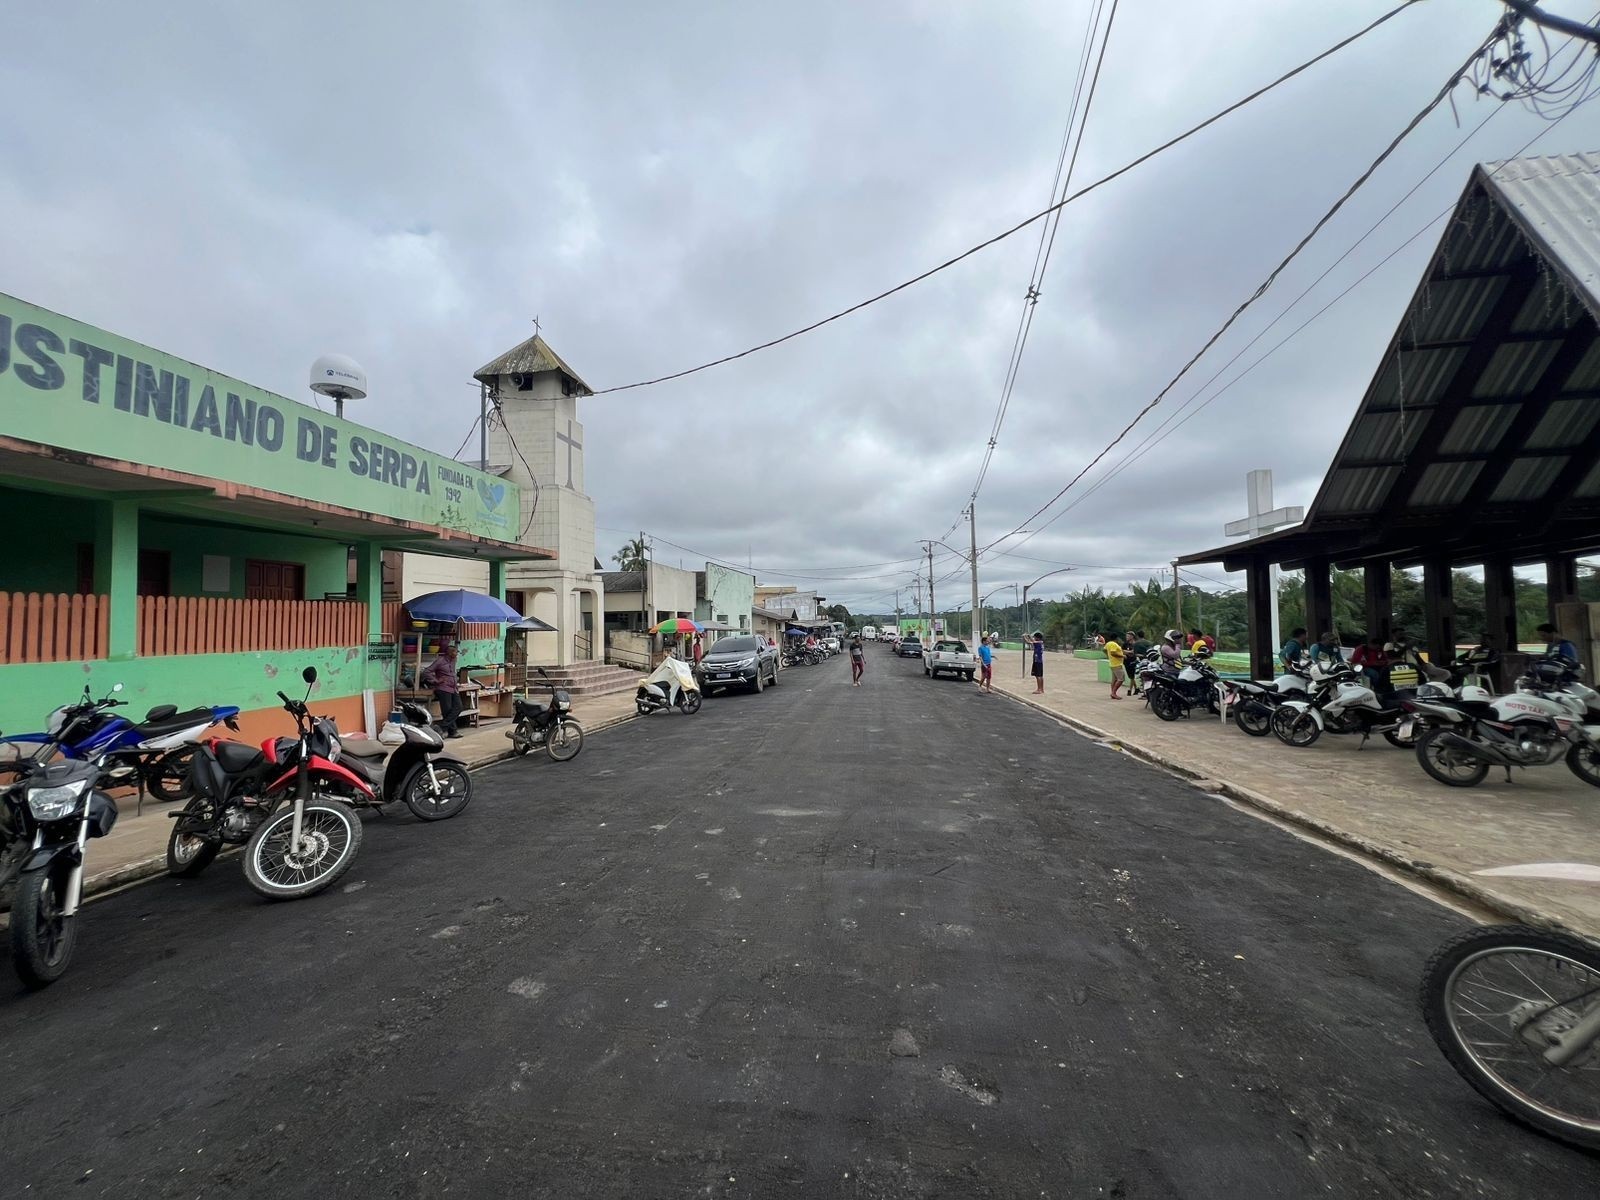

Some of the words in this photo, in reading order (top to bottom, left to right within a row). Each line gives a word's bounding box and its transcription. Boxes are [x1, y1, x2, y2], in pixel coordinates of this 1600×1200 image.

[0, 313, 284, 452] STINIANO
[297, 416, 338, 469] DE
[349, 436, 431, 495] SERPA
[438, 465, 465, 488] FUNDADA
[445, 487, 462, 503] 1942
[1505, 701, 1527, 711] MOTO
